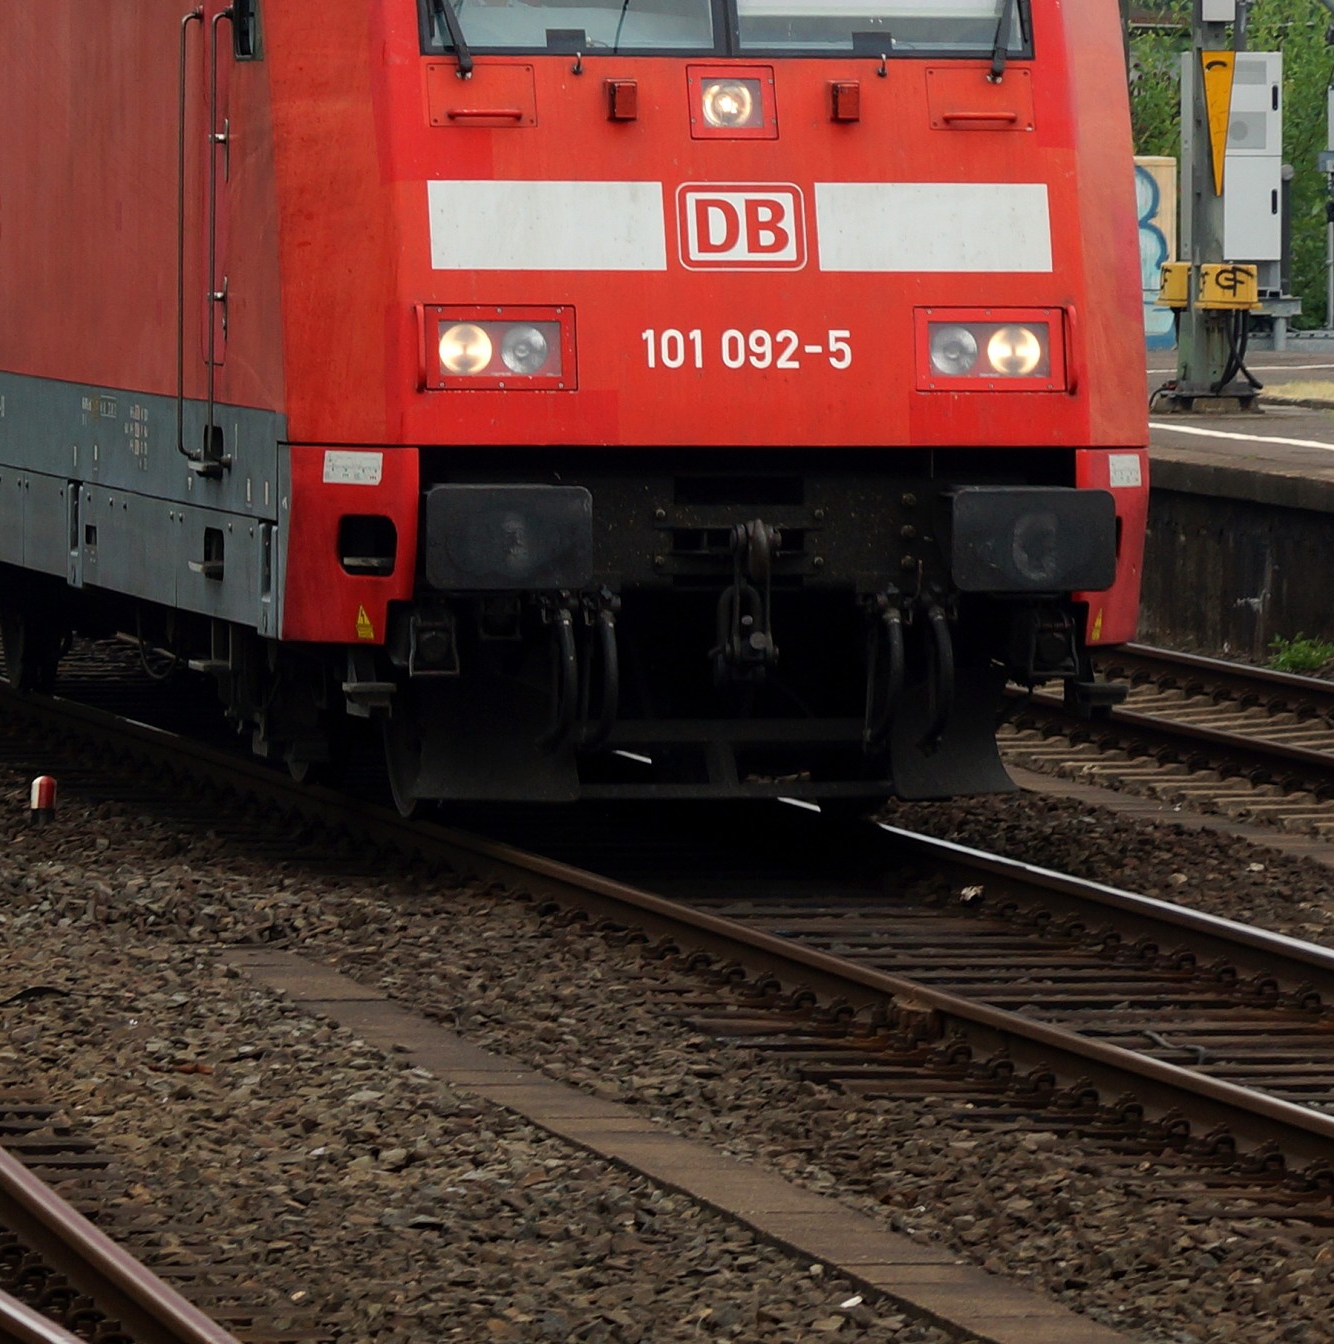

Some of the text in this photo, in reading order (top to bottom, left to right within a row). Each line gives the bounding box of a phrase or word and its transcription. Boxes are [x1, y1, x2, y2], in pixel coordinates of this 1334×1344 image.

[694, 198, 790, 254] DB
[641, 328, 853, 370] 101 092-5
